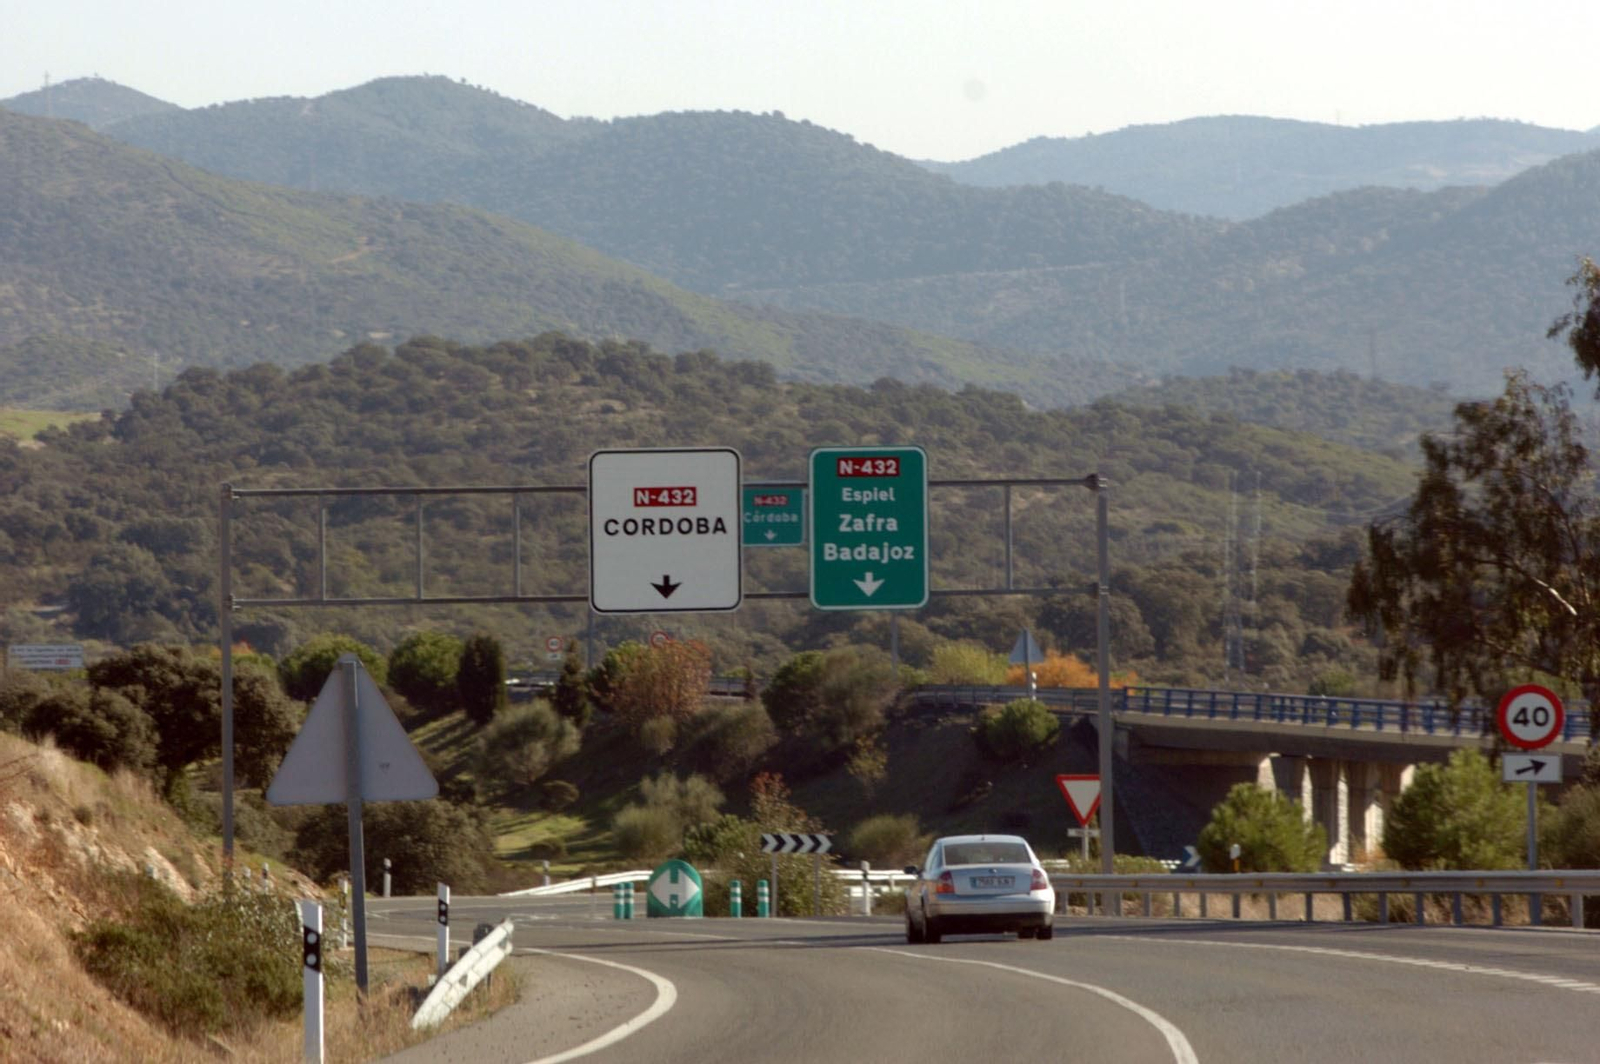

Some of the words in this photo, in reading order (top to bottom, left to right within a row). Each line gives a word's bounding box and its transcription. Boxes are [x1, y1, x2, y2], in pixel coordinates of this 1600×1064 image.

[839, 460, 898, 475] N-432
[636, 489, 695, 505] N-432
[841, 487, 895, 503] Espiel
[604, 517, 728, 536] CORDOBA
[838, 513, 898, 532] Zafra
[823, 543, 915, 564] Badajoz
[1513, 707, 1549, 727] 40
